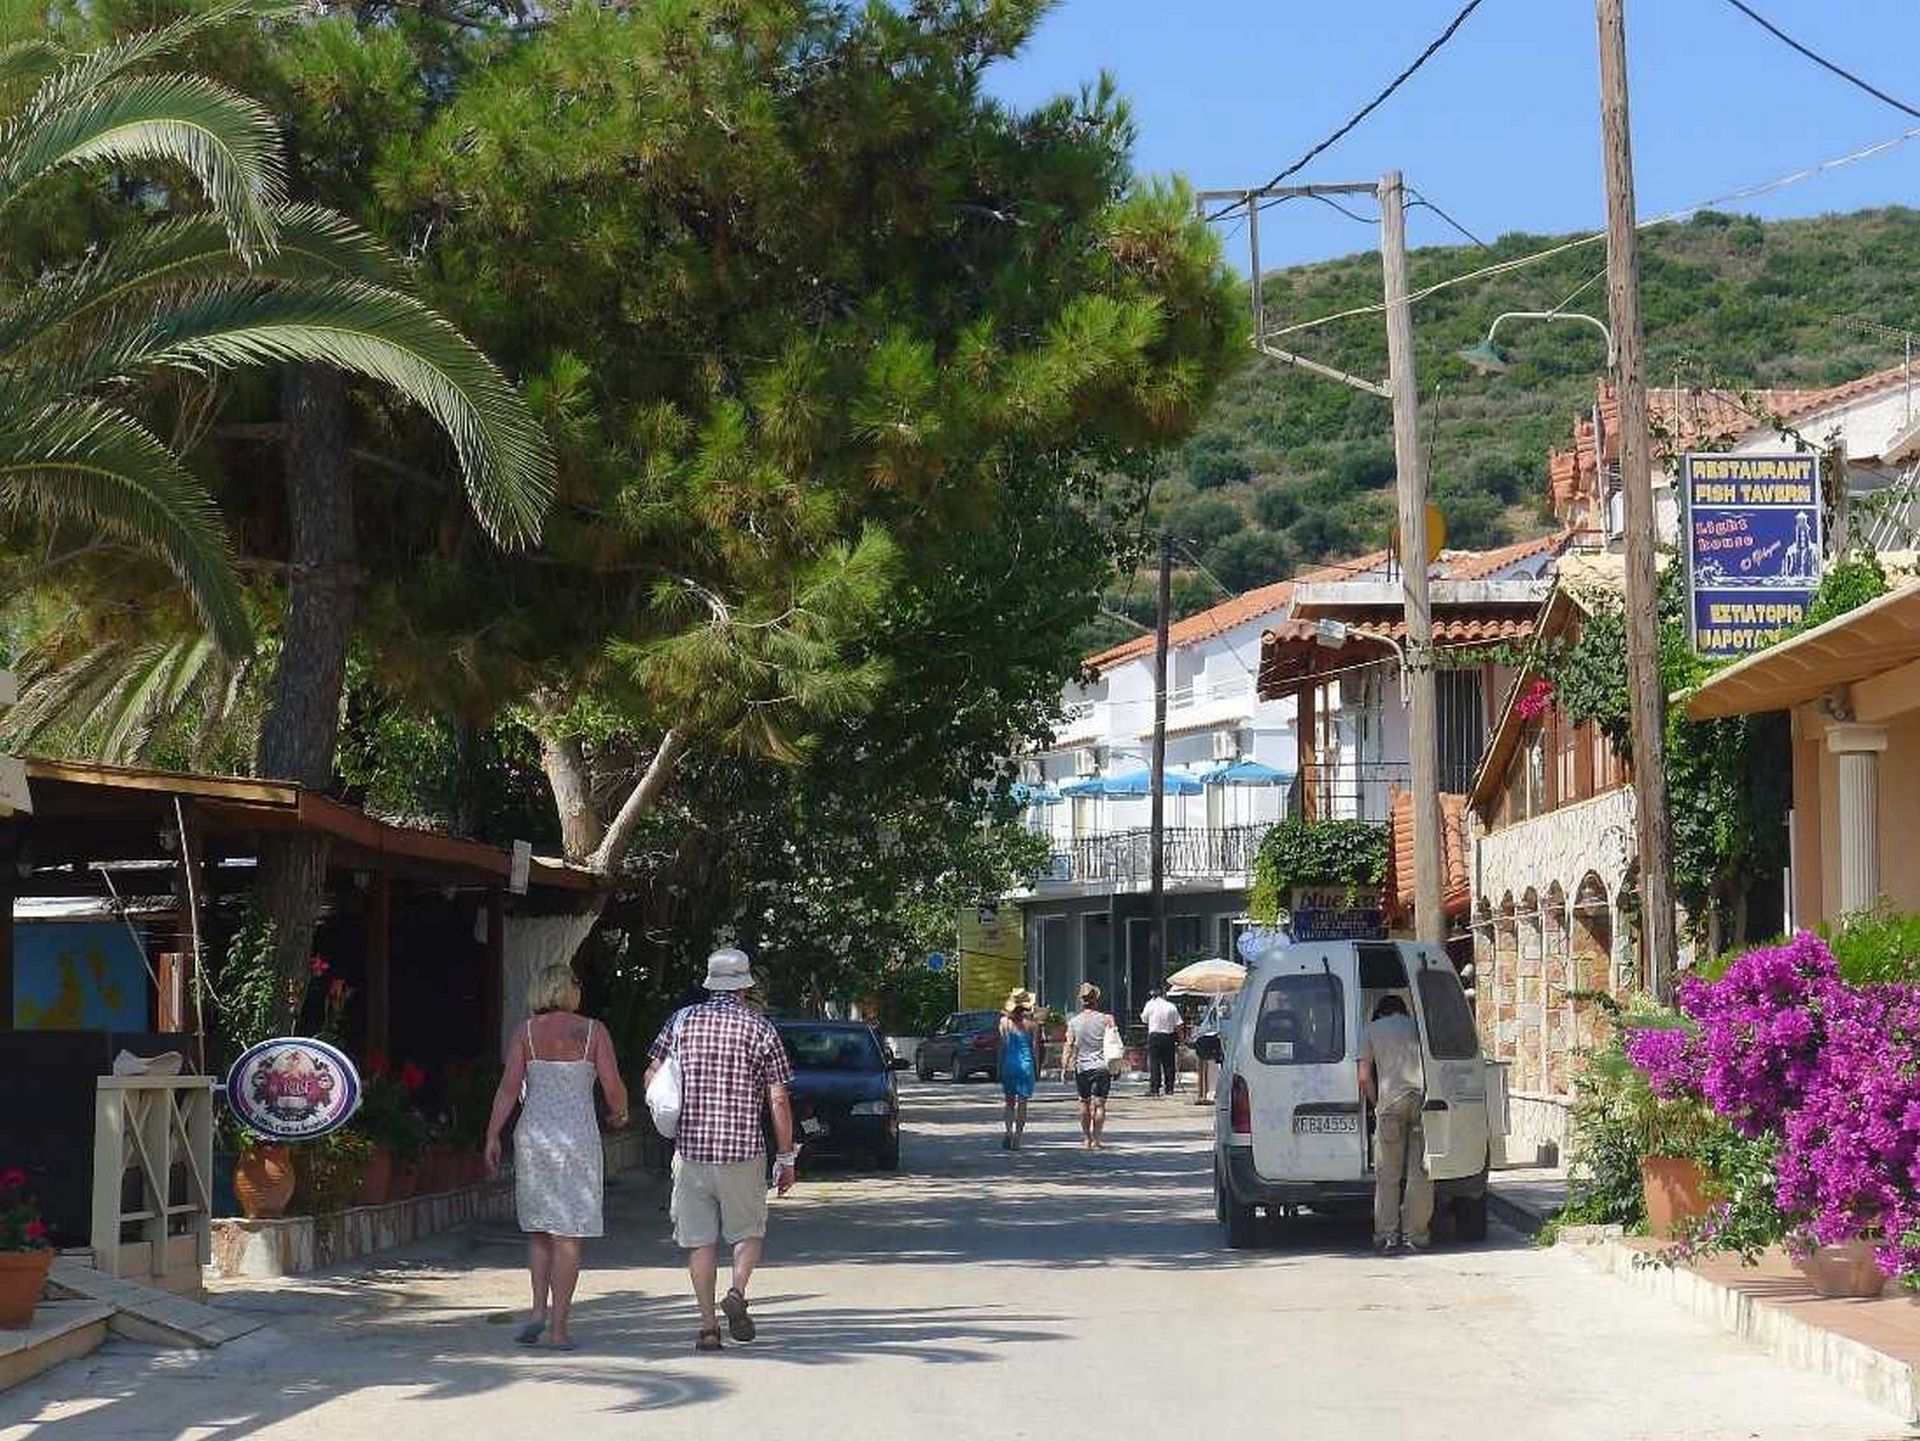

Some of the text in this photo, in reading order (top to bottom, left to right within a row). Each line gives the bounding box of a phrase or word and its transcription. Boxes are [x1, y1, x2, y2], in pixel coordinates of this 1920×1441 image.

[1693, 461, 1811, 480] RESTAURANT
[1696, 484, 1811, 503] FISH TAVERN
